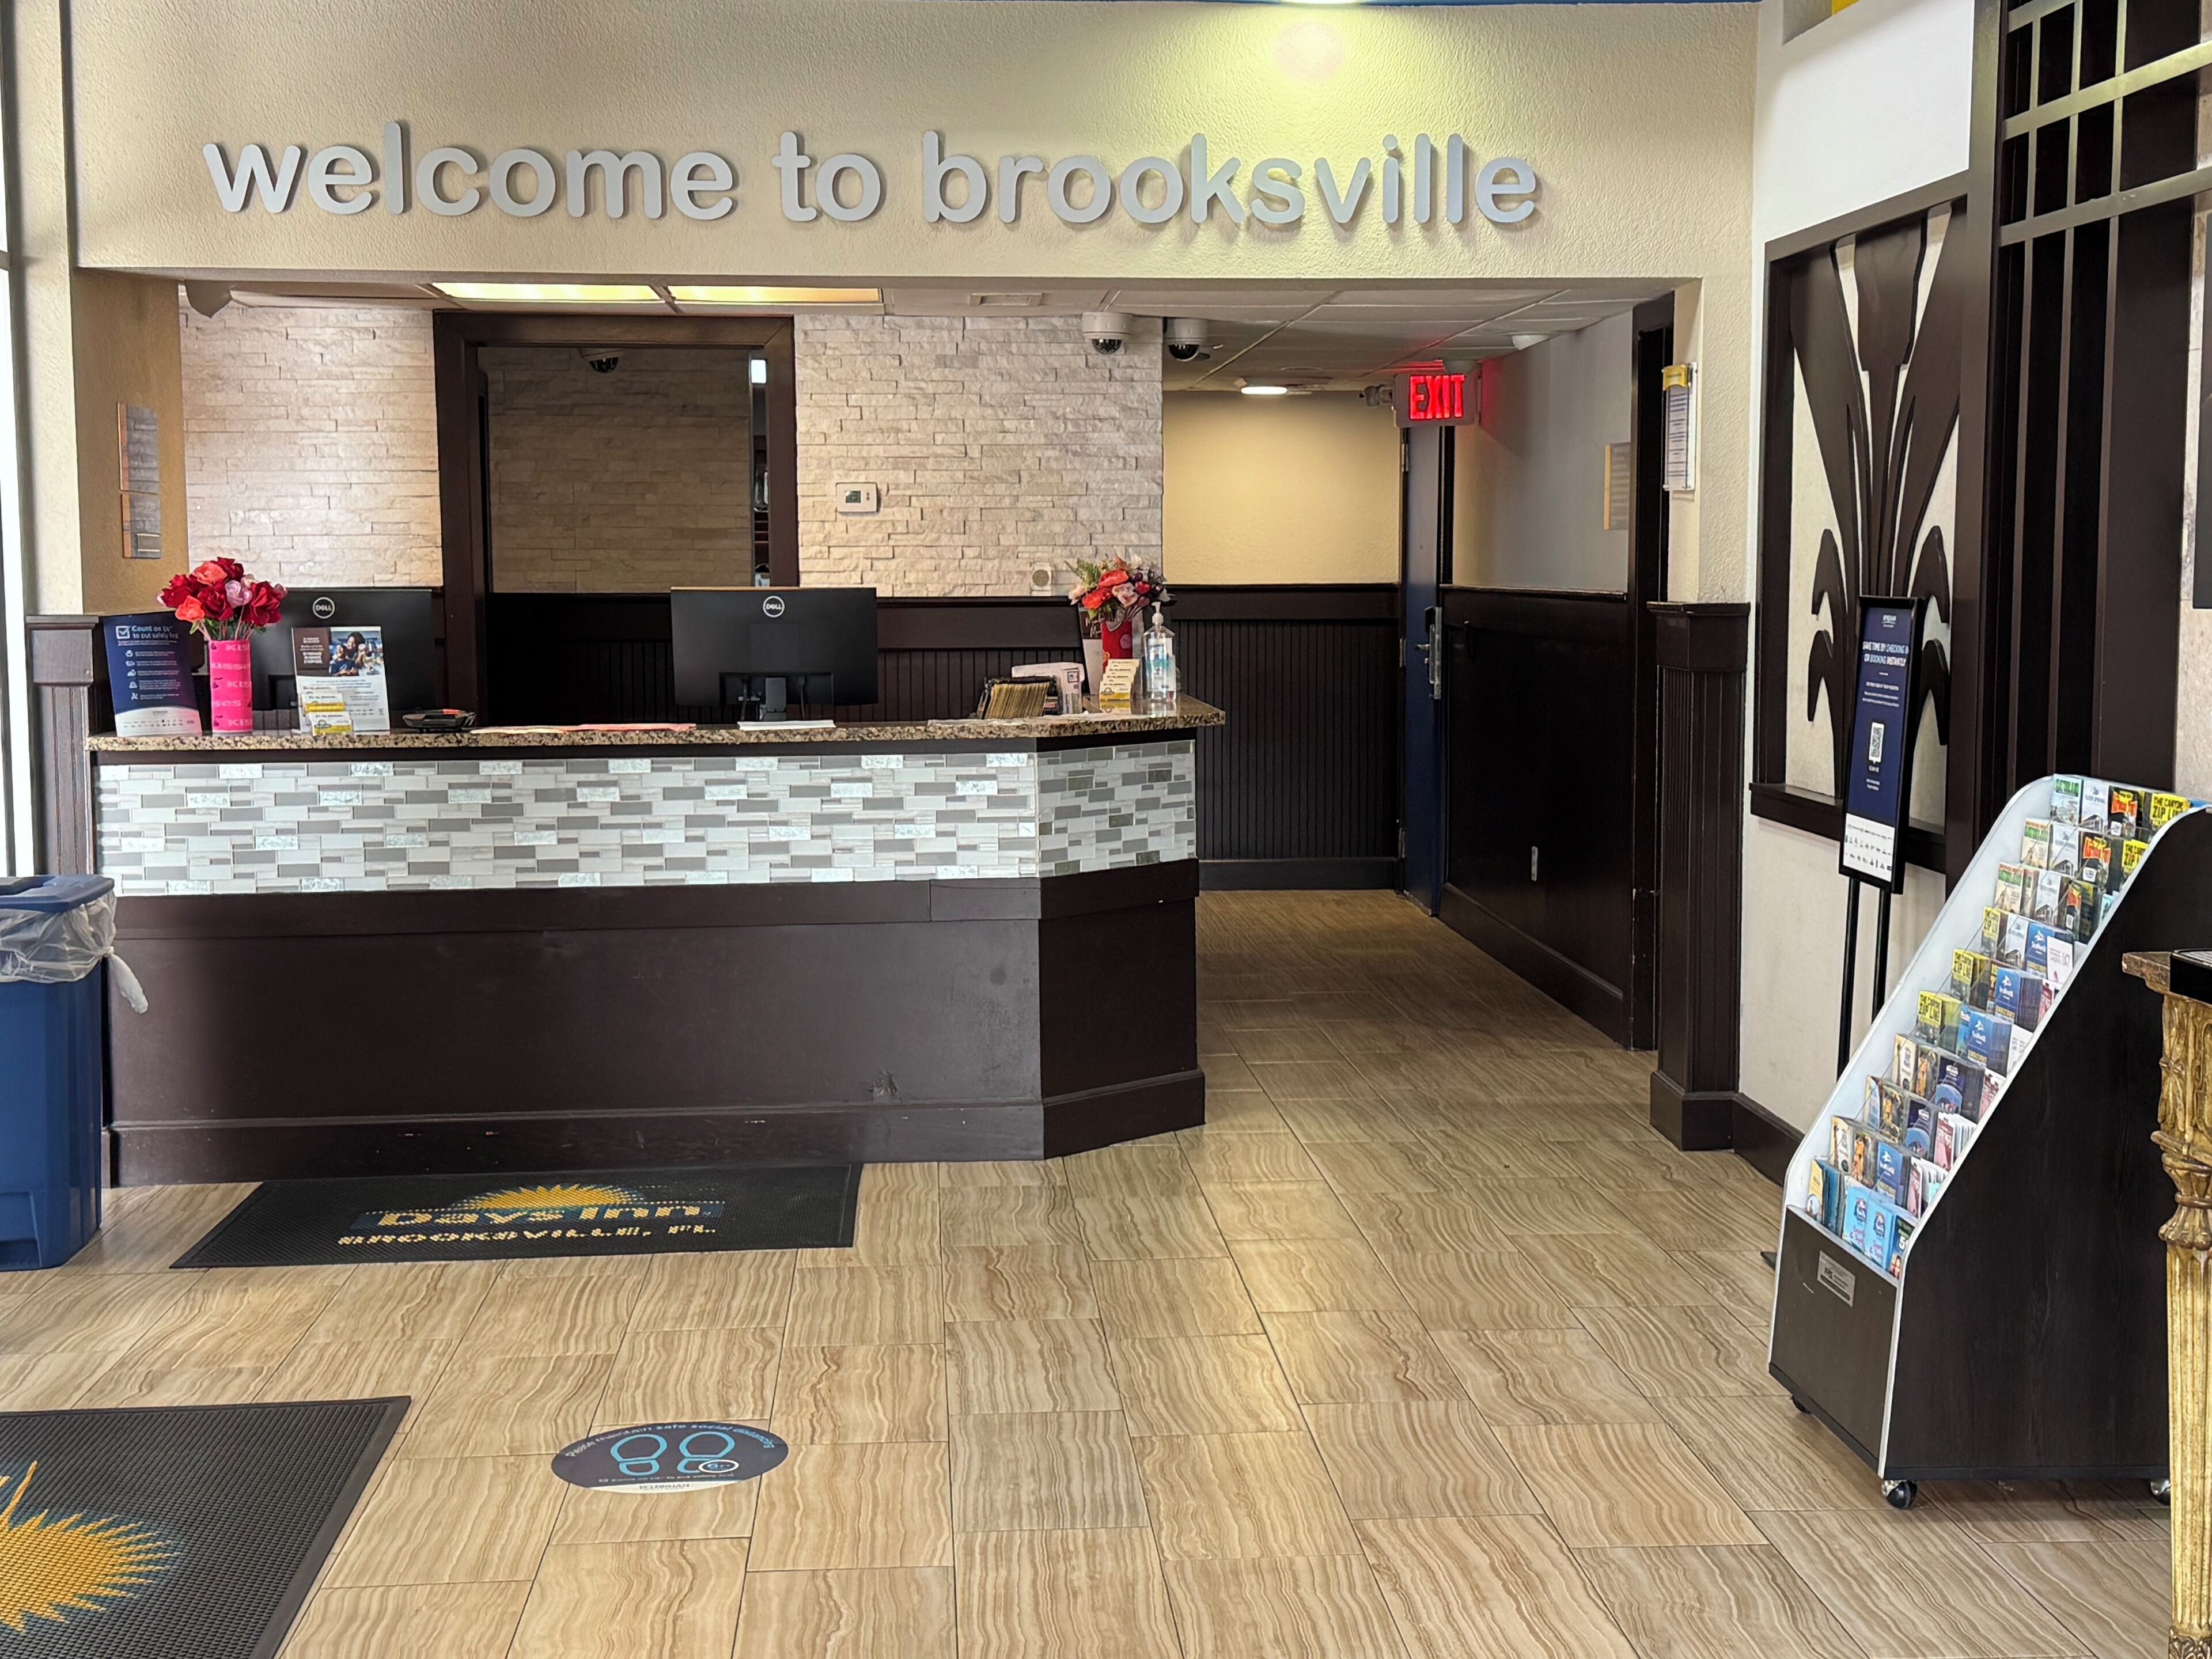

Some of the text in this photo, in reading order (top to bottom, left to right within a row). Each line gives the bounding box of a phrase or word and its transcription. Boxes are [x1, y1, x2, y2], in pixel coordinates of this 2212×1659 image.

[202, 120, 1537, 224] welcome to brooksville
[1409, 374, 1466, 421] EXIT
[2152, 805, 2166, 819] ZIP
[378, 1206, 700, 1226] Days Inn
[596, 1426, 652, 1442] maintain
